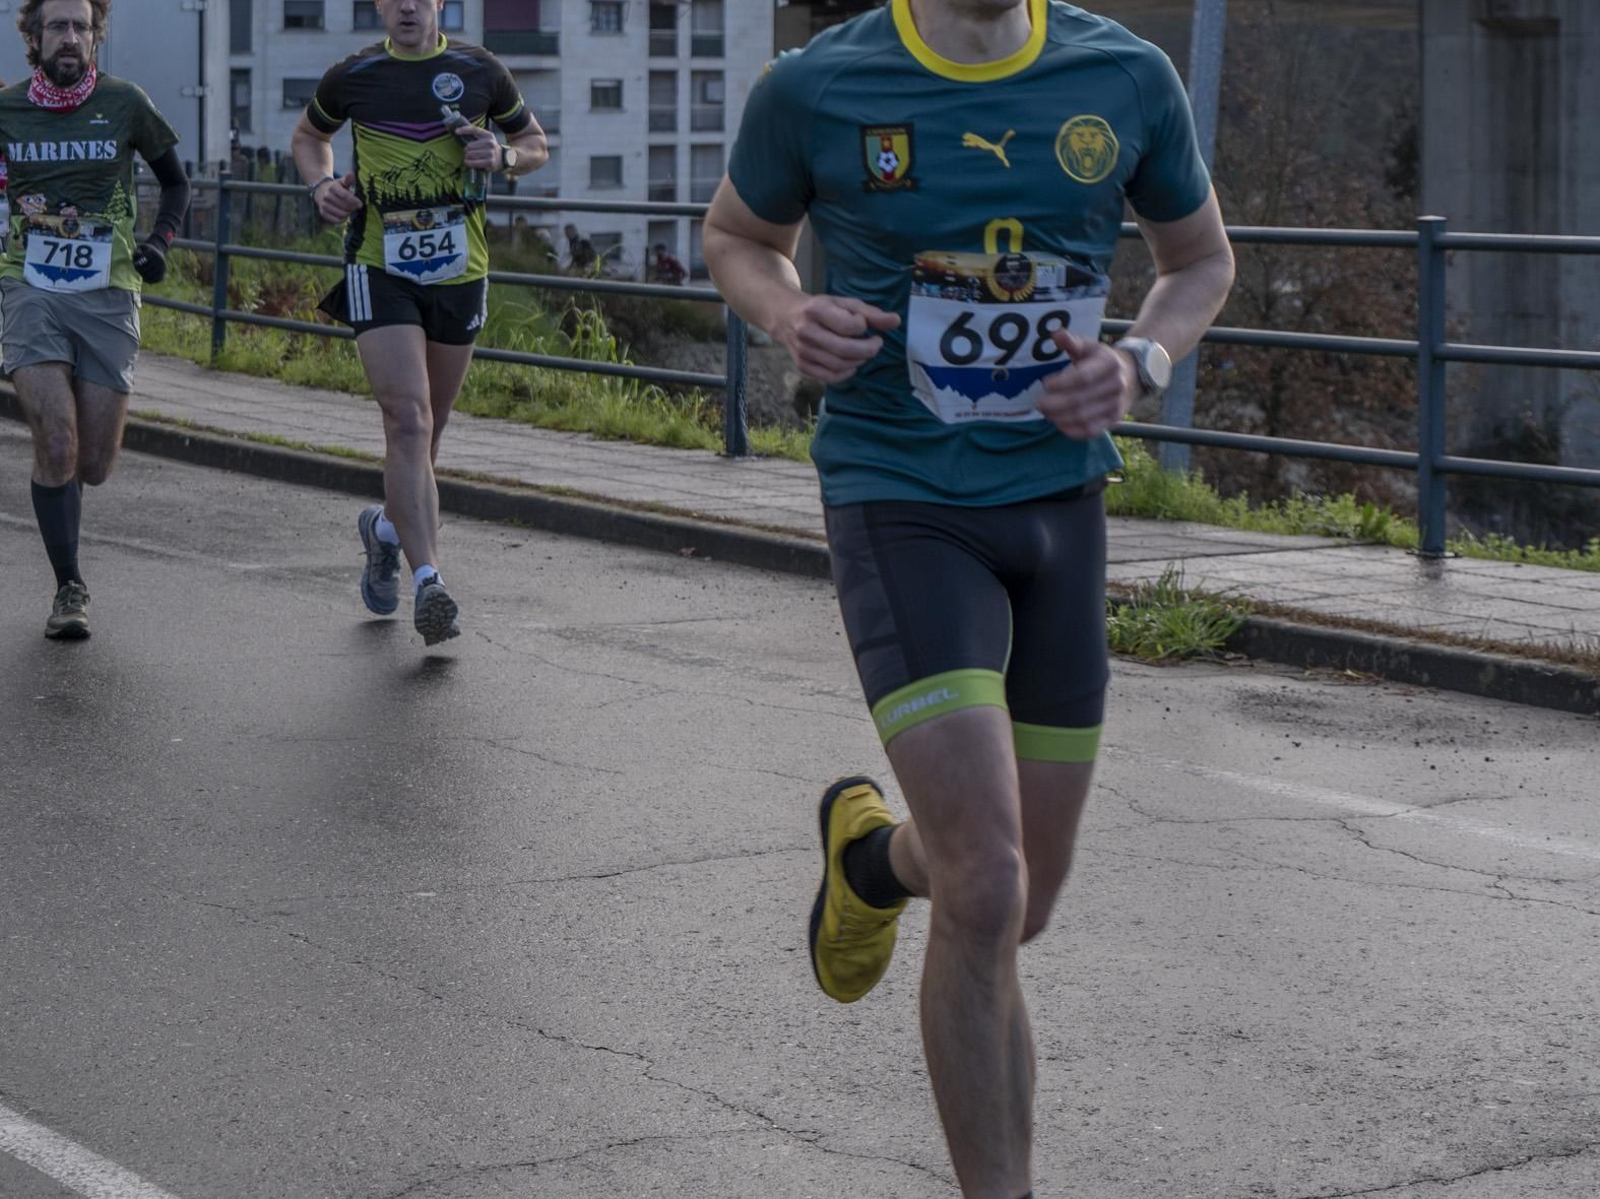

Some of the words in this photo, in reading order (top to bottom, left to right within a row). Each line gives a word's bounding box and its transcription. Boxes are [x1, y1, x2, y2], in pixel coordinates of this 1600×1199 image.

[8, 140, 117, 161] MARINES
[43, 240, 93, 268] 718
[398, 231, 456, 260] 654
[939, 310, 1071, 366] 698
